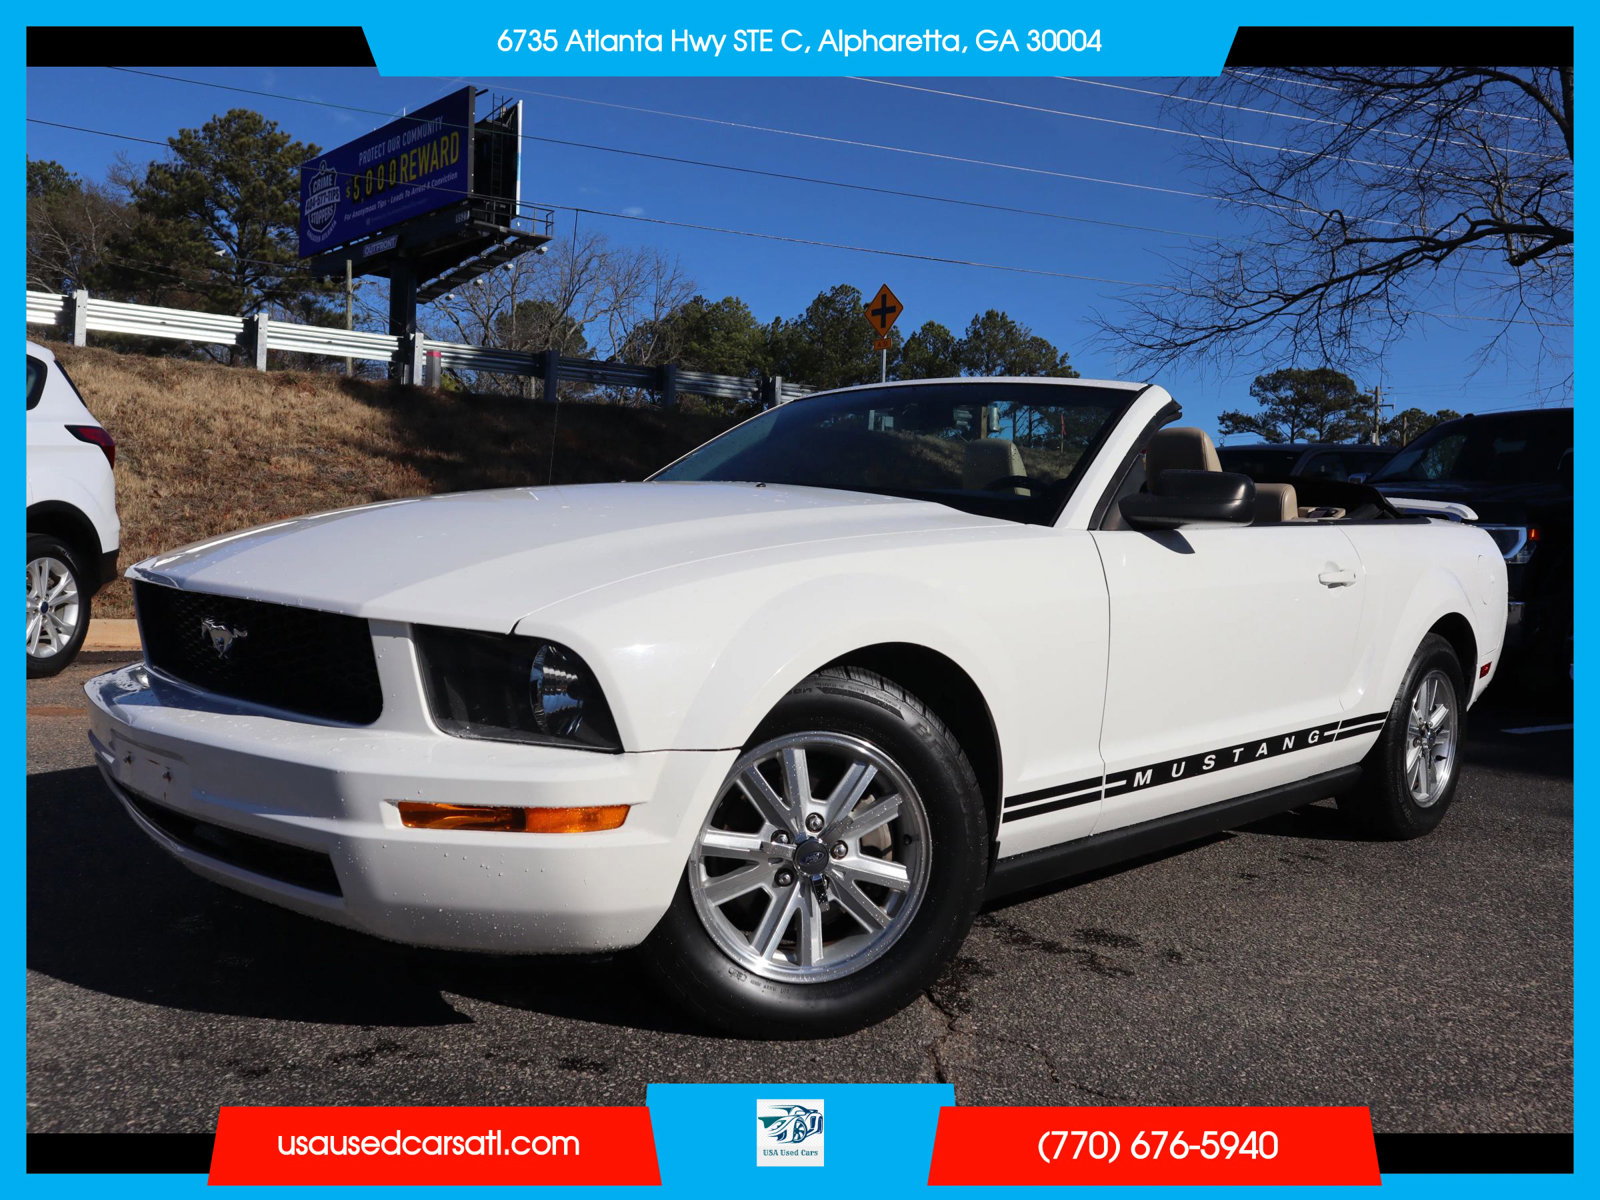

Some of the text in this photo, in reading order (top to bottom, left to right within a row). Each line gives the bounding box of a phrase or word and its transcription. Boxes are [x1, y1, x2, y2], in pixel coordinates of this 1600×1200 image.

[358, 116, 444, 166] PROTECT OUR COMMUNITY
[400, 131, 460, 185] REWARD
[312, 173, 334, 194] CRIME
[352, 203, 377, 218] Anonymous
[377, 200, 387, 209] Tips
[390, 193, 404, 204] Leads
[405, 188, 411, 197] To
[411, 184, 427, 195] Arrest
[431, 171, 458, 188] Conviction
[1132, 729, 1320, 788] MUSTANG
